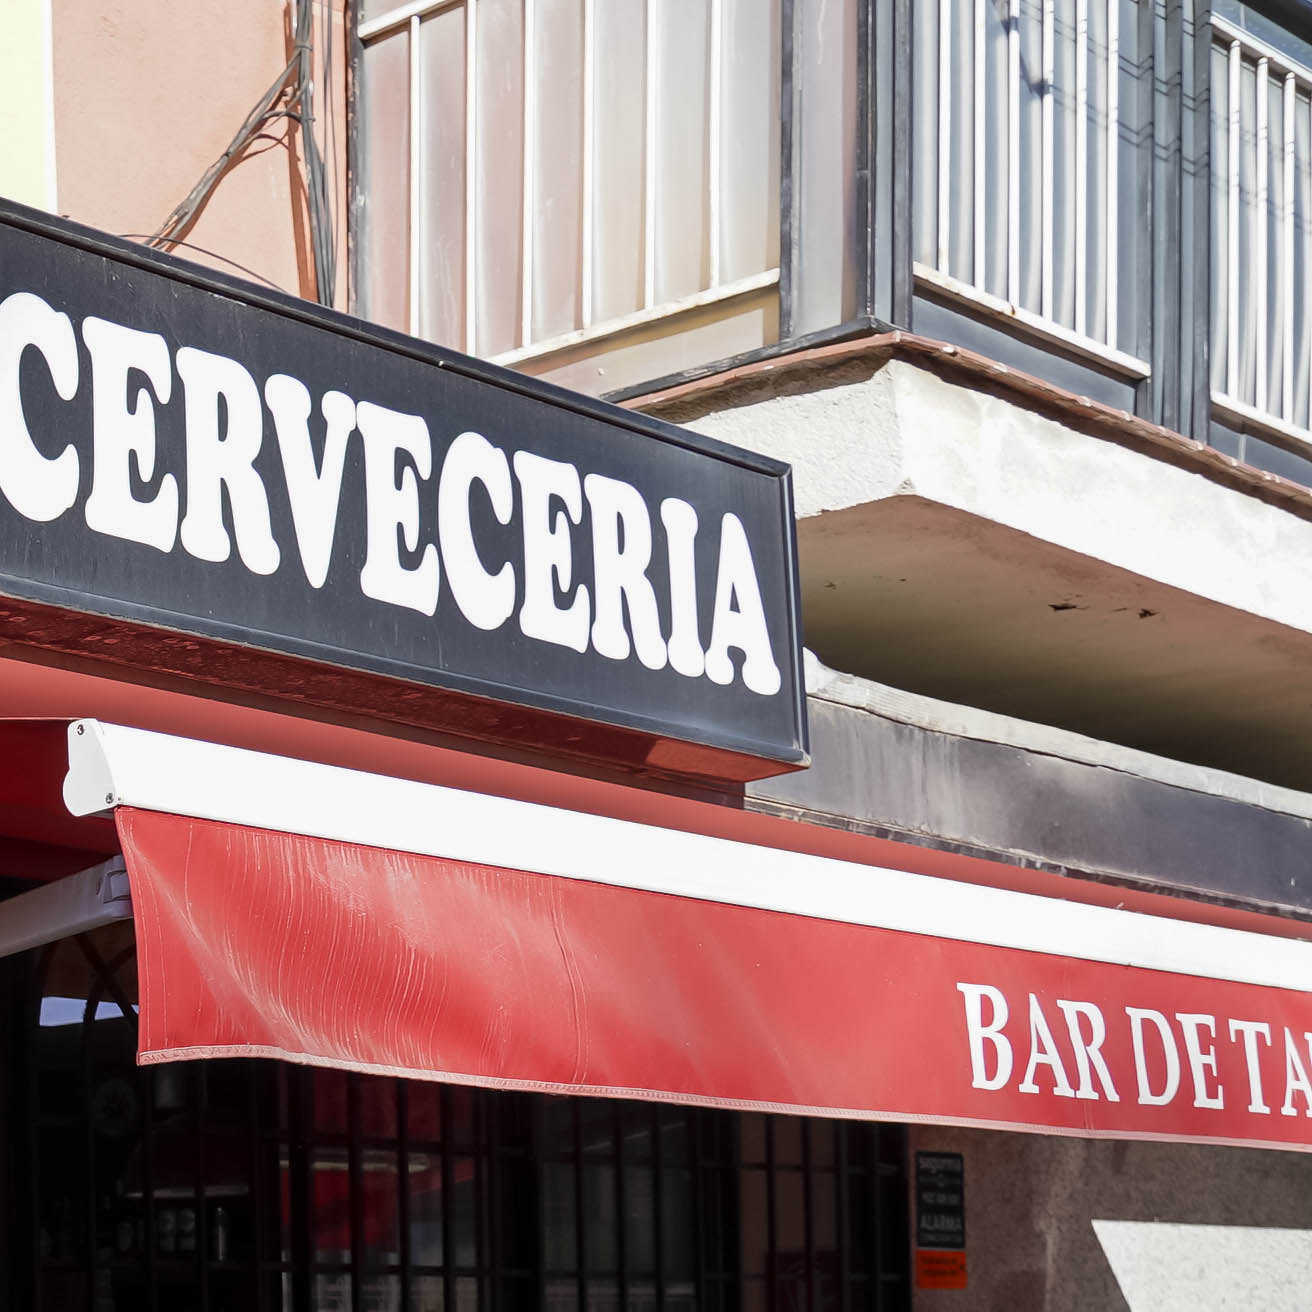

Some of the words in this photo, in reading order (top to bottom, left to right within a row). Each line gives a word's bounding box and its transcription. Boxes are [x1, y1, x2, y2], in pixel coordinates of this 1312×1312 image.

[956, 982, 1120, 1103] BAR
[1125, 1006, 1224, 1110] DE
[1229, 1018, 1312, 1118] TA
